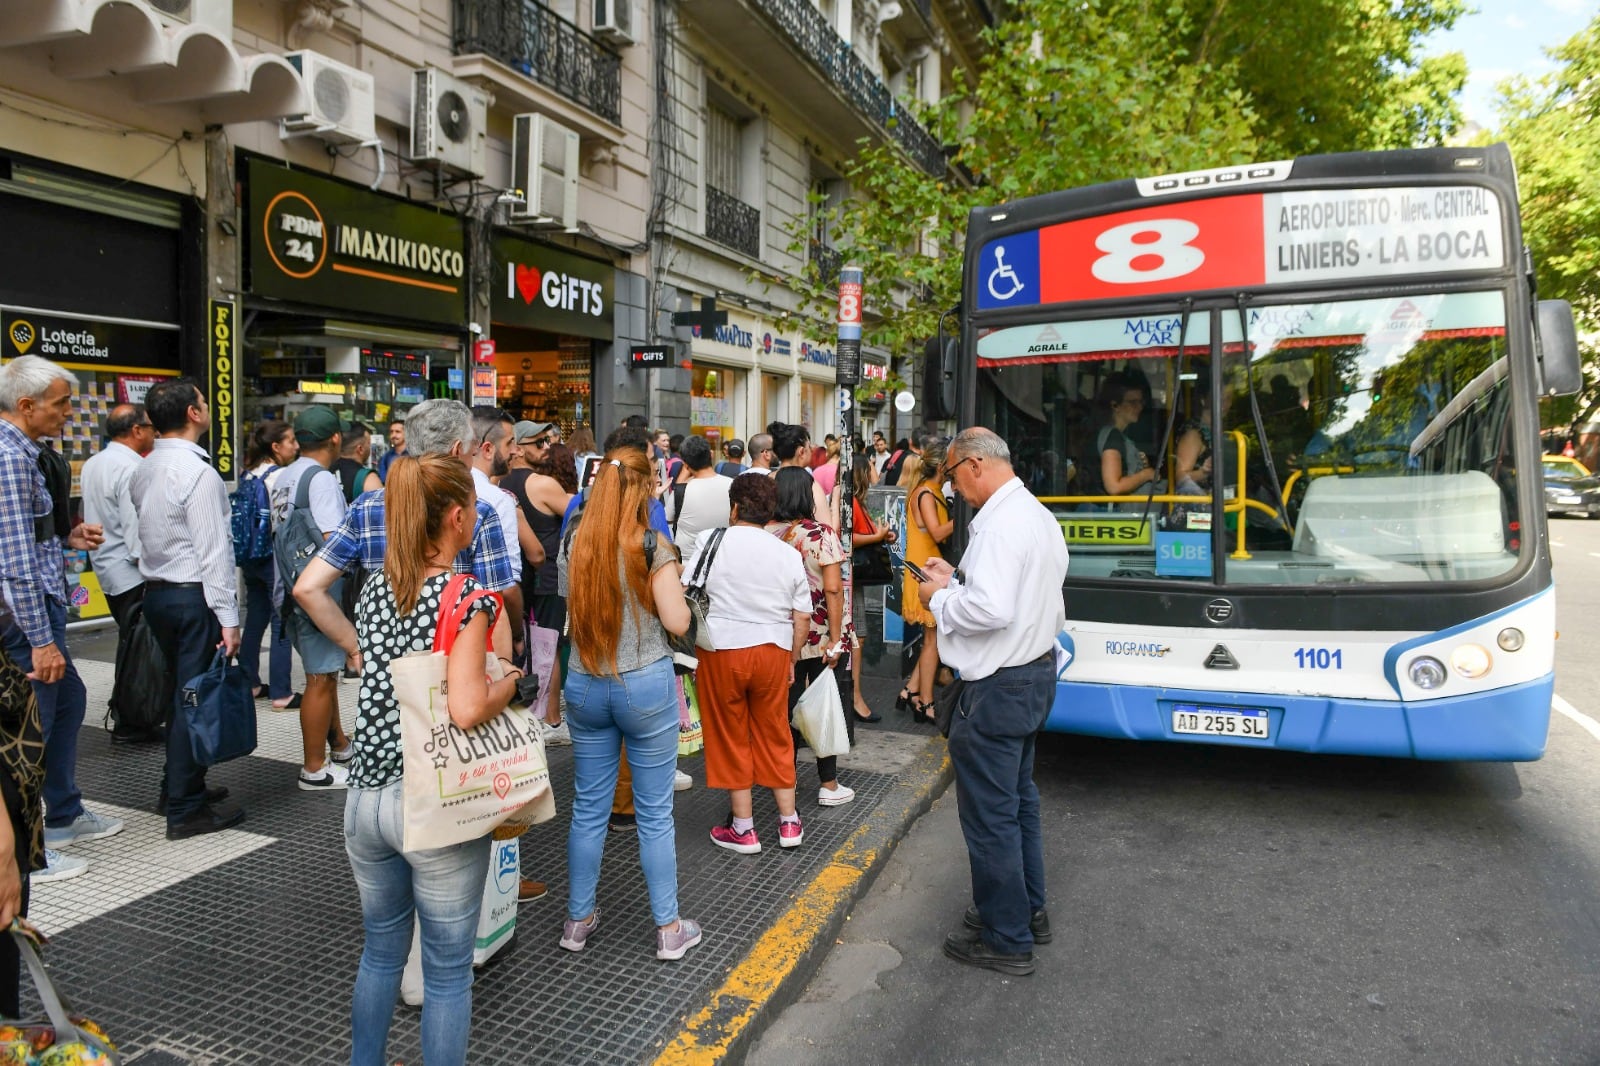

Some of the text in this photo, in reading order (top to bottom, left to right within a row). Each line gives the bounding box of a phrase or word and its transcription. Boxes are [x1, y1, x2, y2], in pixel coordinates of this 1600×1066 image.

[1279, 188, 1489, 232] AEROPUERTO Merc. CENTRAL
[280, 213, 323, 238] PDM
[285, 239, 315, 262] 24
[340, 224, 464, 278] MAXIKIOSCO
[1091, 218, 1205, 284] 8
[1278, 230, 1489, 271] LINIERS LA BOCA
[507, 262, 604, 317] I GiFTS
[840, 295, 858, 321] 8
[41, 326, 95, 346] Lotería
[1124, 318, 1182, 334] MEGA
[1027, 343, 1069, 353] AGRALE
[1134, 331, 1174, 345] CAR
[41, 342, 108, 358] de la Ciudad
[215, 306, 233, 472] FOTOCOPIAS
[1160, 541, 1207, 560] SUBE
[1294, 648, 1342, 669] 1101
[1178, 714, 1263, 735] AD 255 SL
[448, 712, 526, 764] CERCA
[458, 771, 469, 787] y
[473, 764, 487, 778] eso
